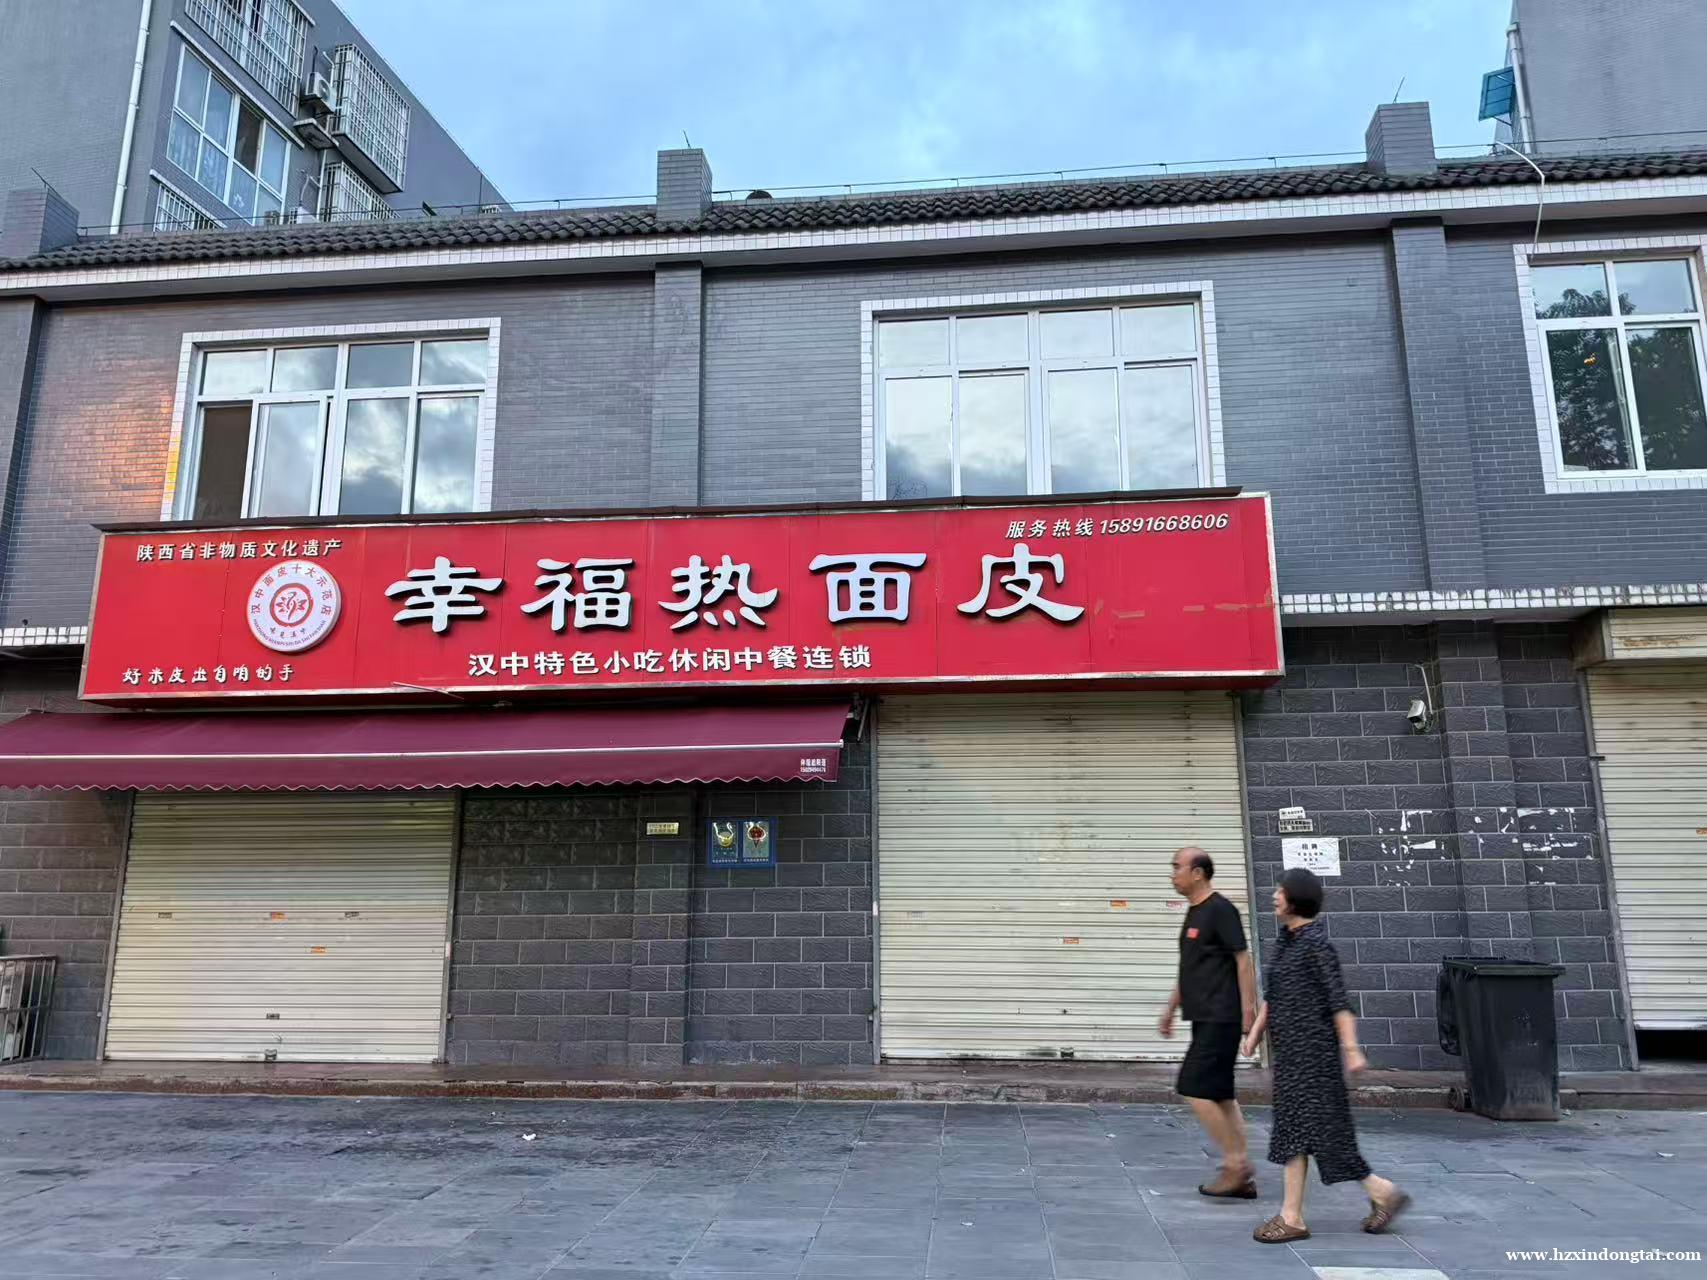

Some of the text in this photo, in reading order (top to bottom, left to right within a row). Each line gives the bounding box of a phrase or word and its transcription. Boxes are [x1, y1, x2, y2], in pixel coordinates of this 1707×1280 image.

[1006, 513, 1229, 540] 服务热线 15891668606
[136, 539, 341, 561] 陕西省非物质文化遗产
[250, 563, 333, 616] 汉中面皮十大示范店
[386, 544, 1086, 633] 幸福热面皮
[468, 646, 872, 677] 汉中特色小吃休闲中餐连锁
